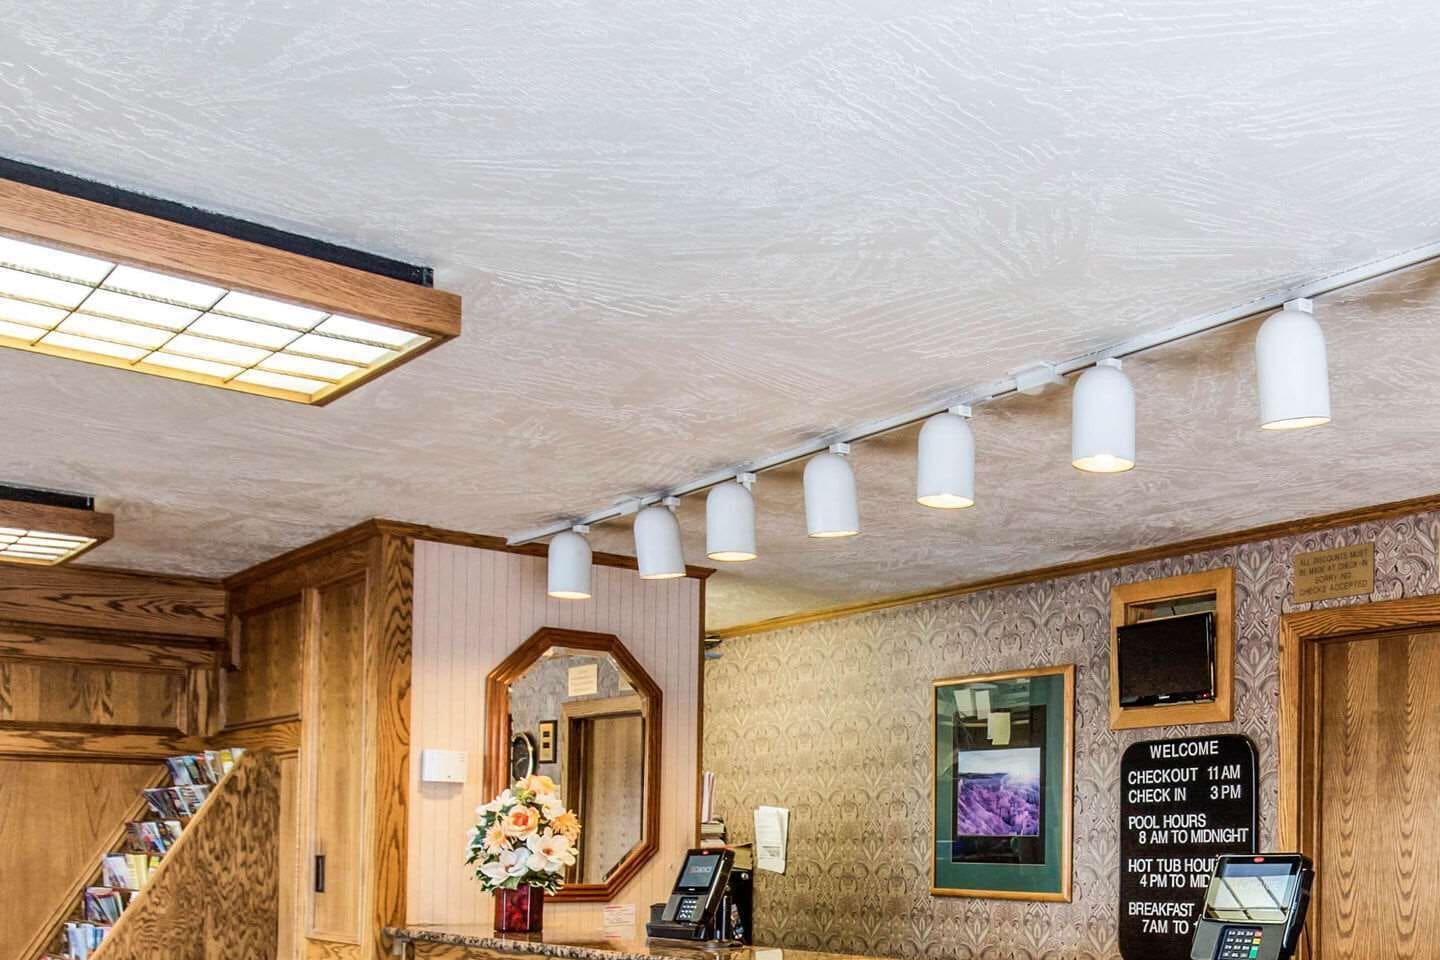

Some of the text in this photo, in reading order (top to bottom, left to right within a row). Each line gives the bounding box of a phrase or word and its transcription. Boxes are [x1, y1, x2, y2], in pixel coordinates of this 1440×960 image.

[1150, 740, 1219, 759] WELCOME
[1128, 764, 1241, 785] CHECKOUT 11 AM
[1128, 784, 1241, 803] CHECK IN 3 PM
[1128, 812, 1206, 830] POOL HOURS
[1138, 827, 1249, 844] 8 AM TO MIDNIGHT
[1128, 857, 1217, 873] HOT TUB HOU
[1139, 874, 1147, 888] 4
[1150, 873, 1168, 888] PM
[1169, 873, 1186, 888] TO
[1128, 902, 1195, 918] BREAKFAST
[1172, 920, 1189, 935] TO
